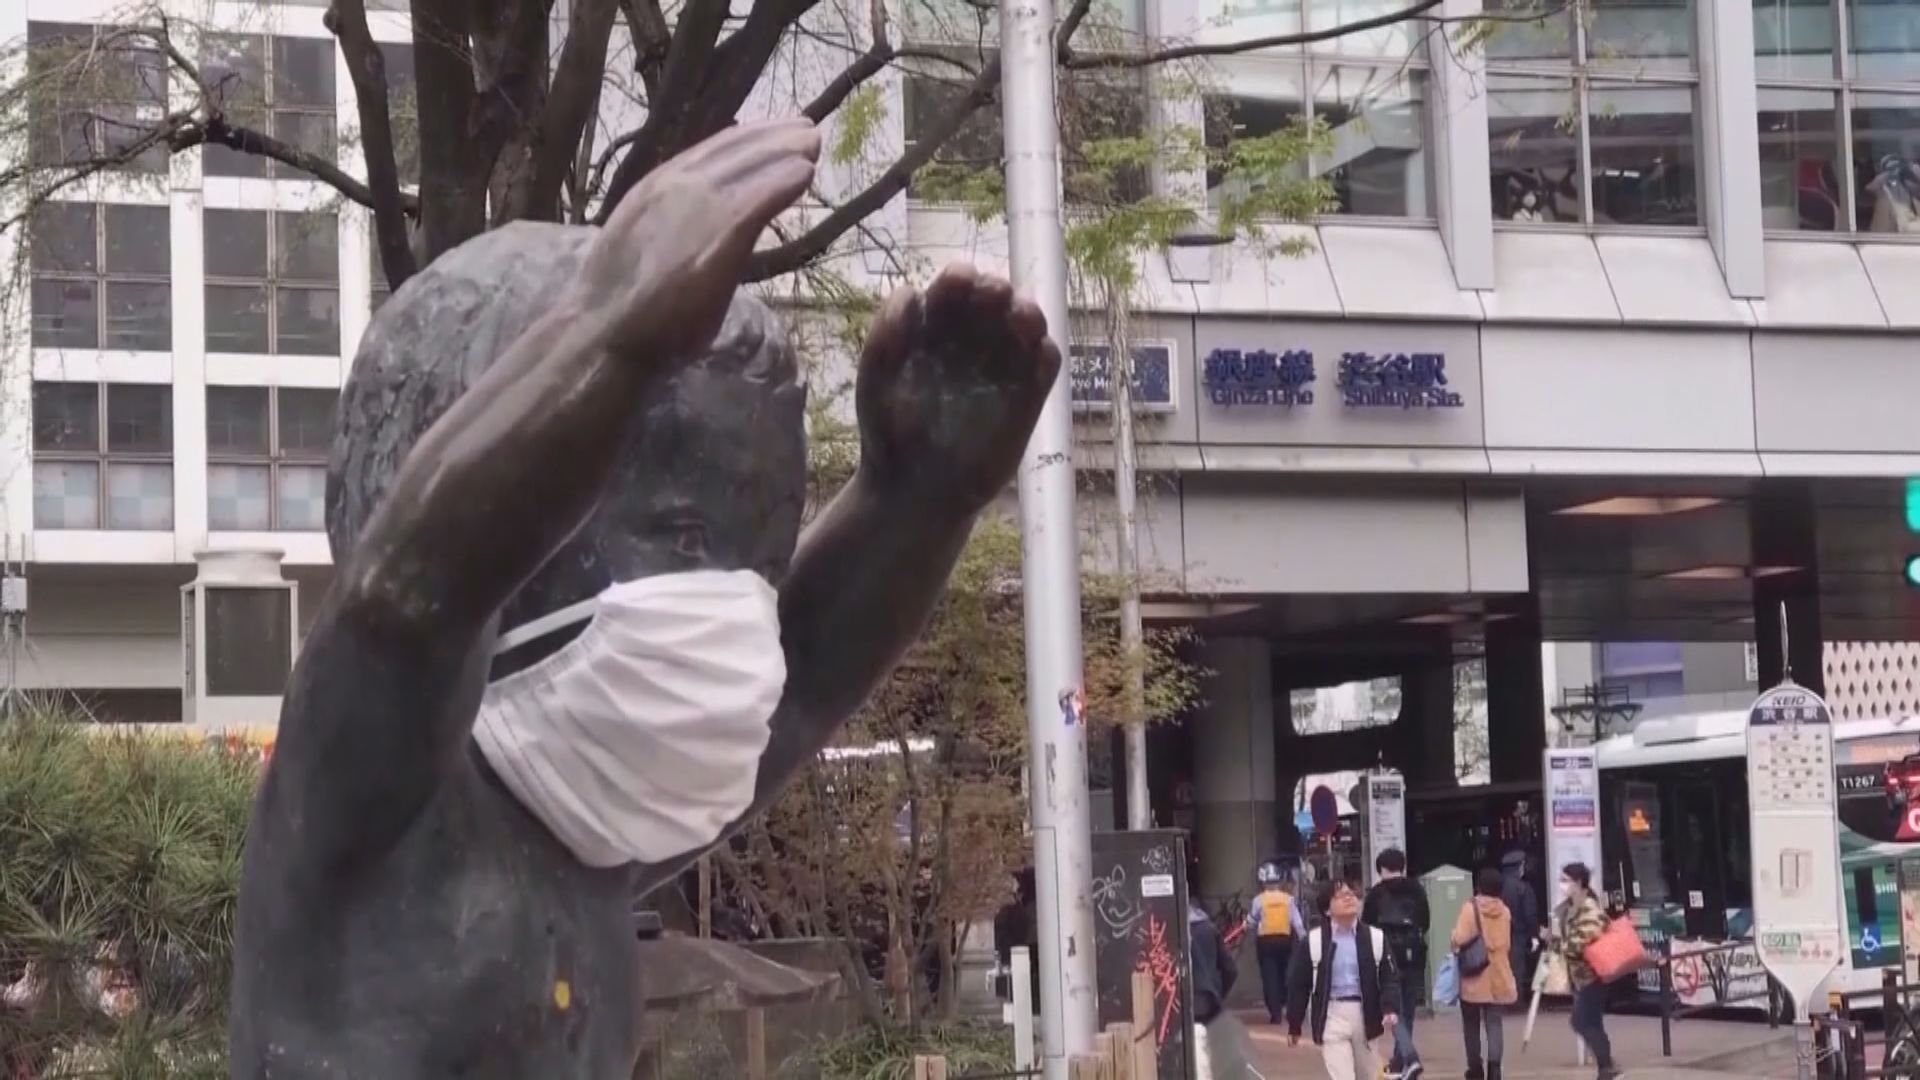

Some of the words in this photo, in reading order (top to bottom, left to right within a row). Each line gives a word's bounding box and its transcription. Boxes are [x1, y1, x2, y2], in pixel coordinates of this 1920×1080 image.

[1204, 348, 1316, 387] 銀座線
[1340, 352, 1448, 387] 渋谷駅
[1210, 384, 1267, 406] Ginza
[1272, 384, 1313, 406] Line
[1344, 386, 1423, 409] Shibuya
[1772, 695, 1806, 706] KEIO
[1841, 776, 1875, 789] T1267
